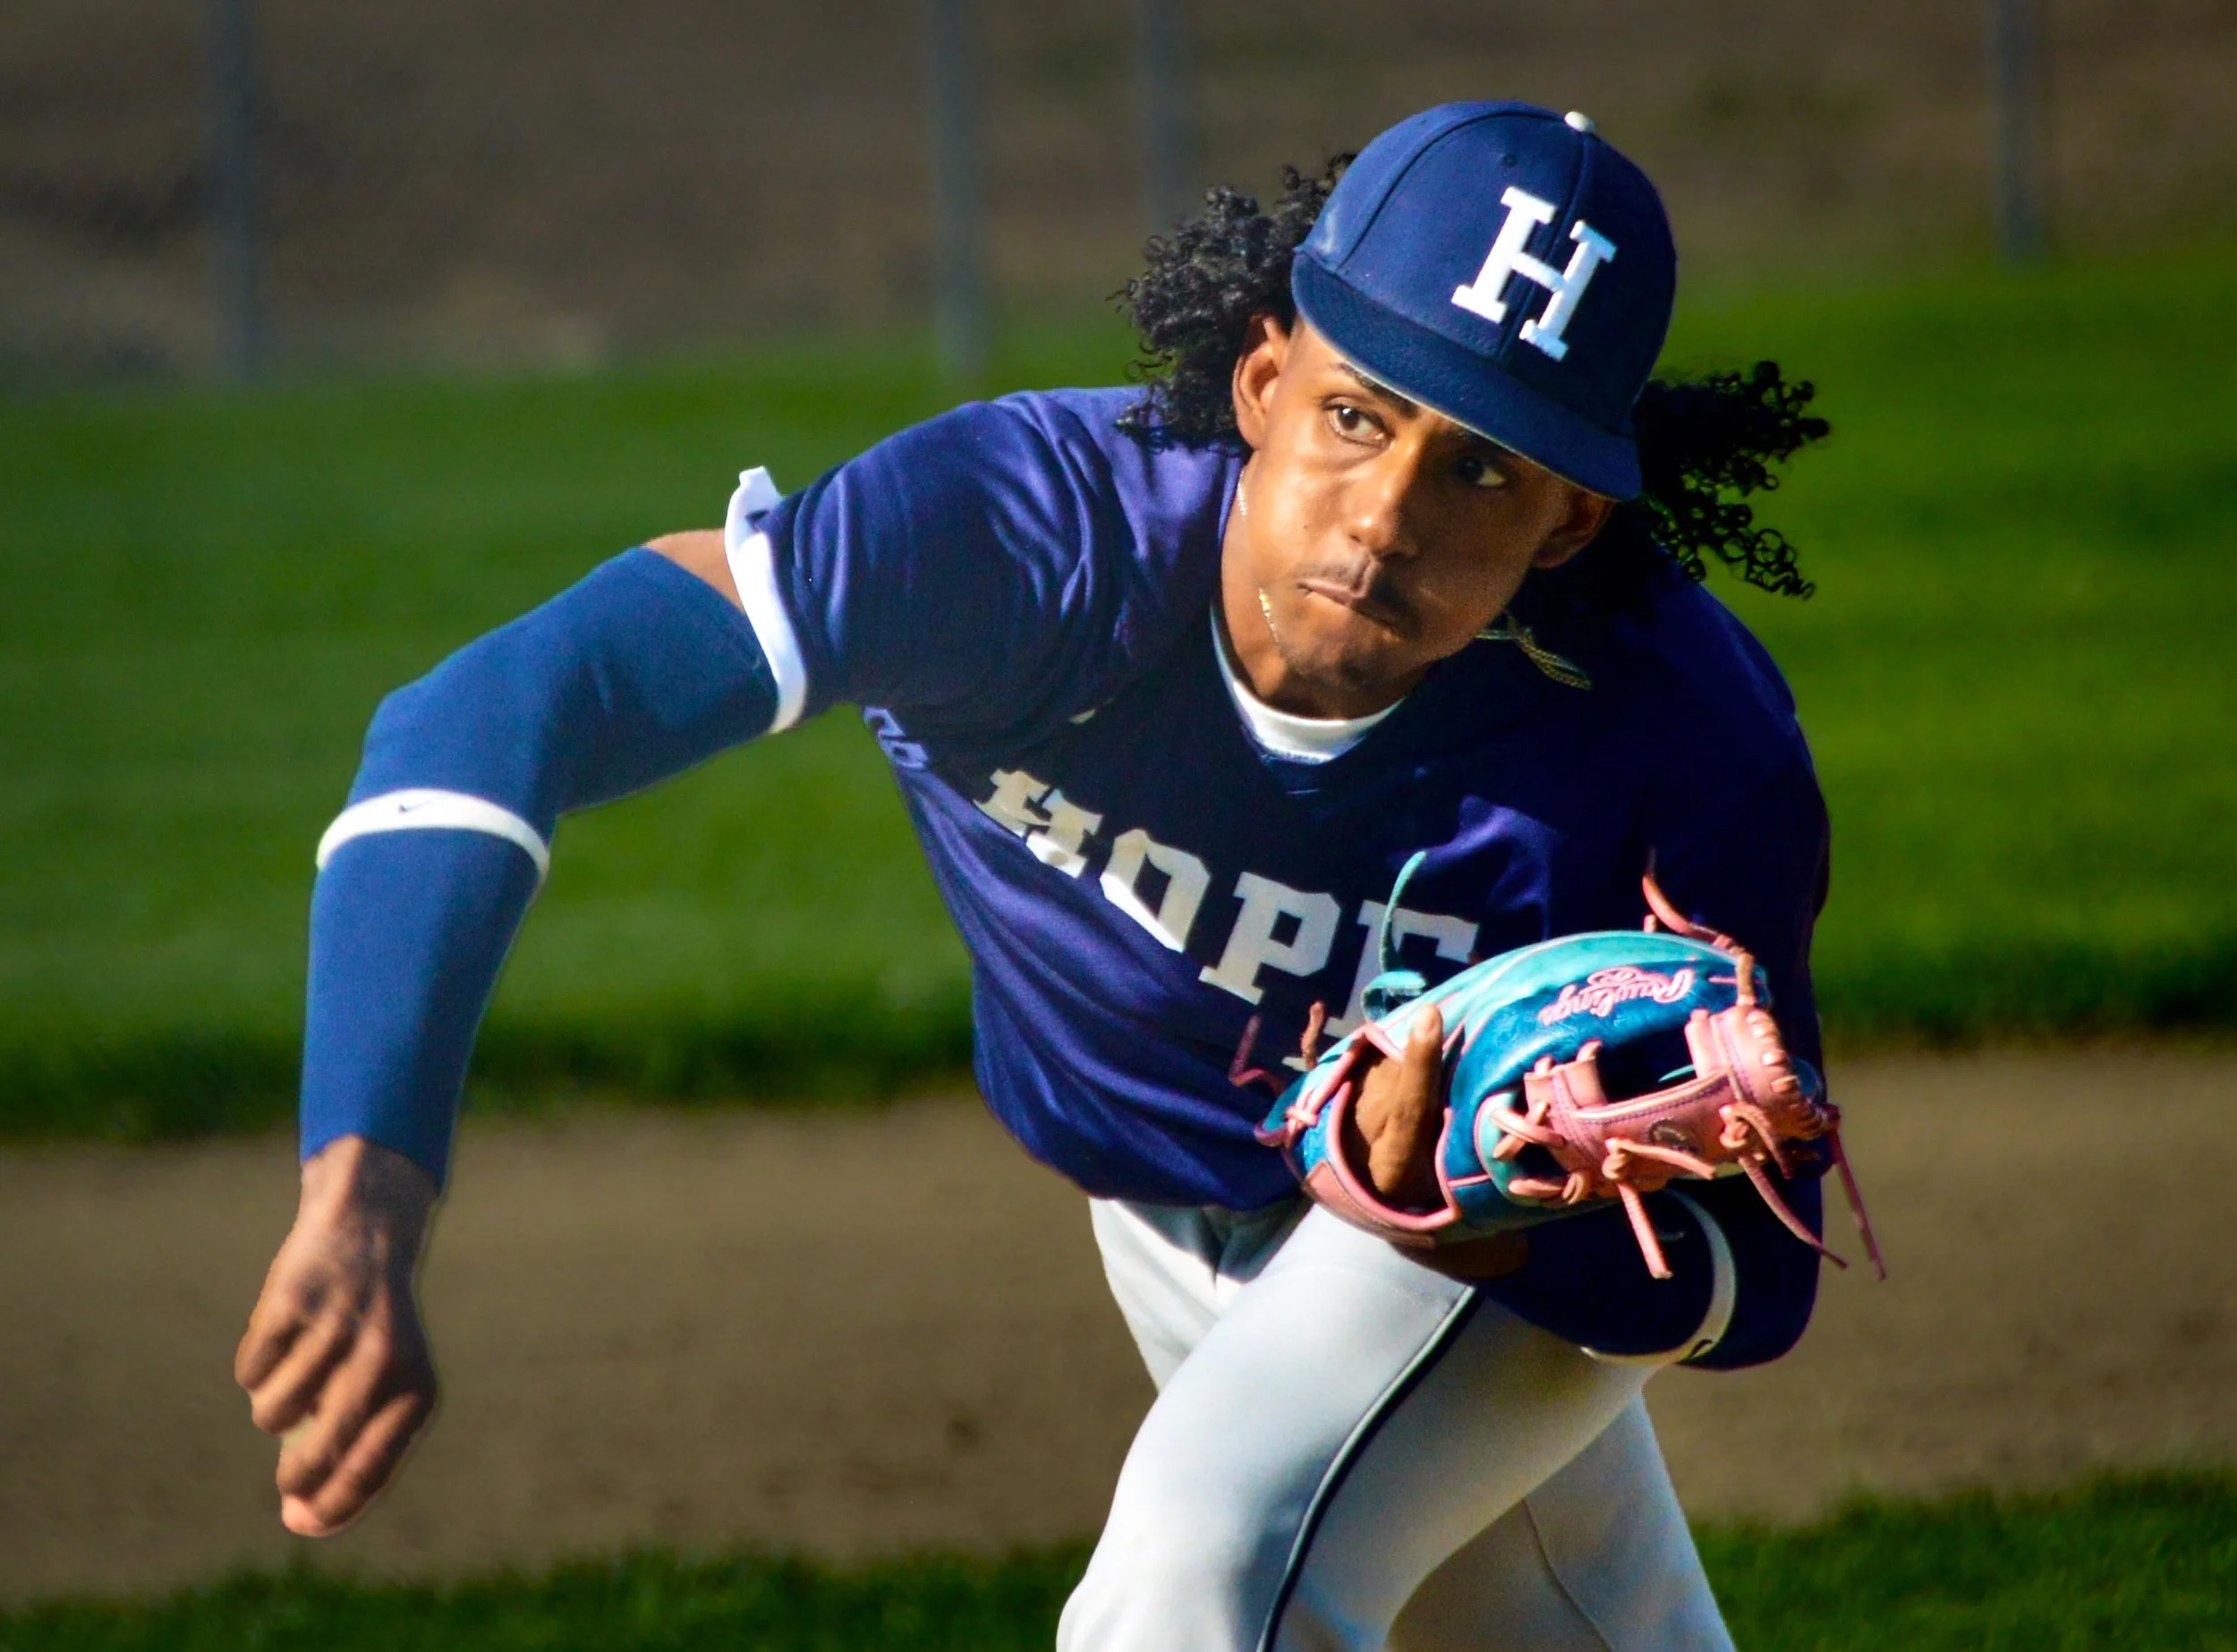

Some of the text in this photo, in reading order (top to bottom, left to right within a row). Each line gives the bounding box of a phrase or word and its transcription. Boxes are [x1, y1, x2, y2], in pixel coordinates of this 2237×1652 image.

[1450, 185, 1617, 362] H
[973, 767, 1479, 1039] HOPE
[1537, 966, 1697, 1026] Rawlings
